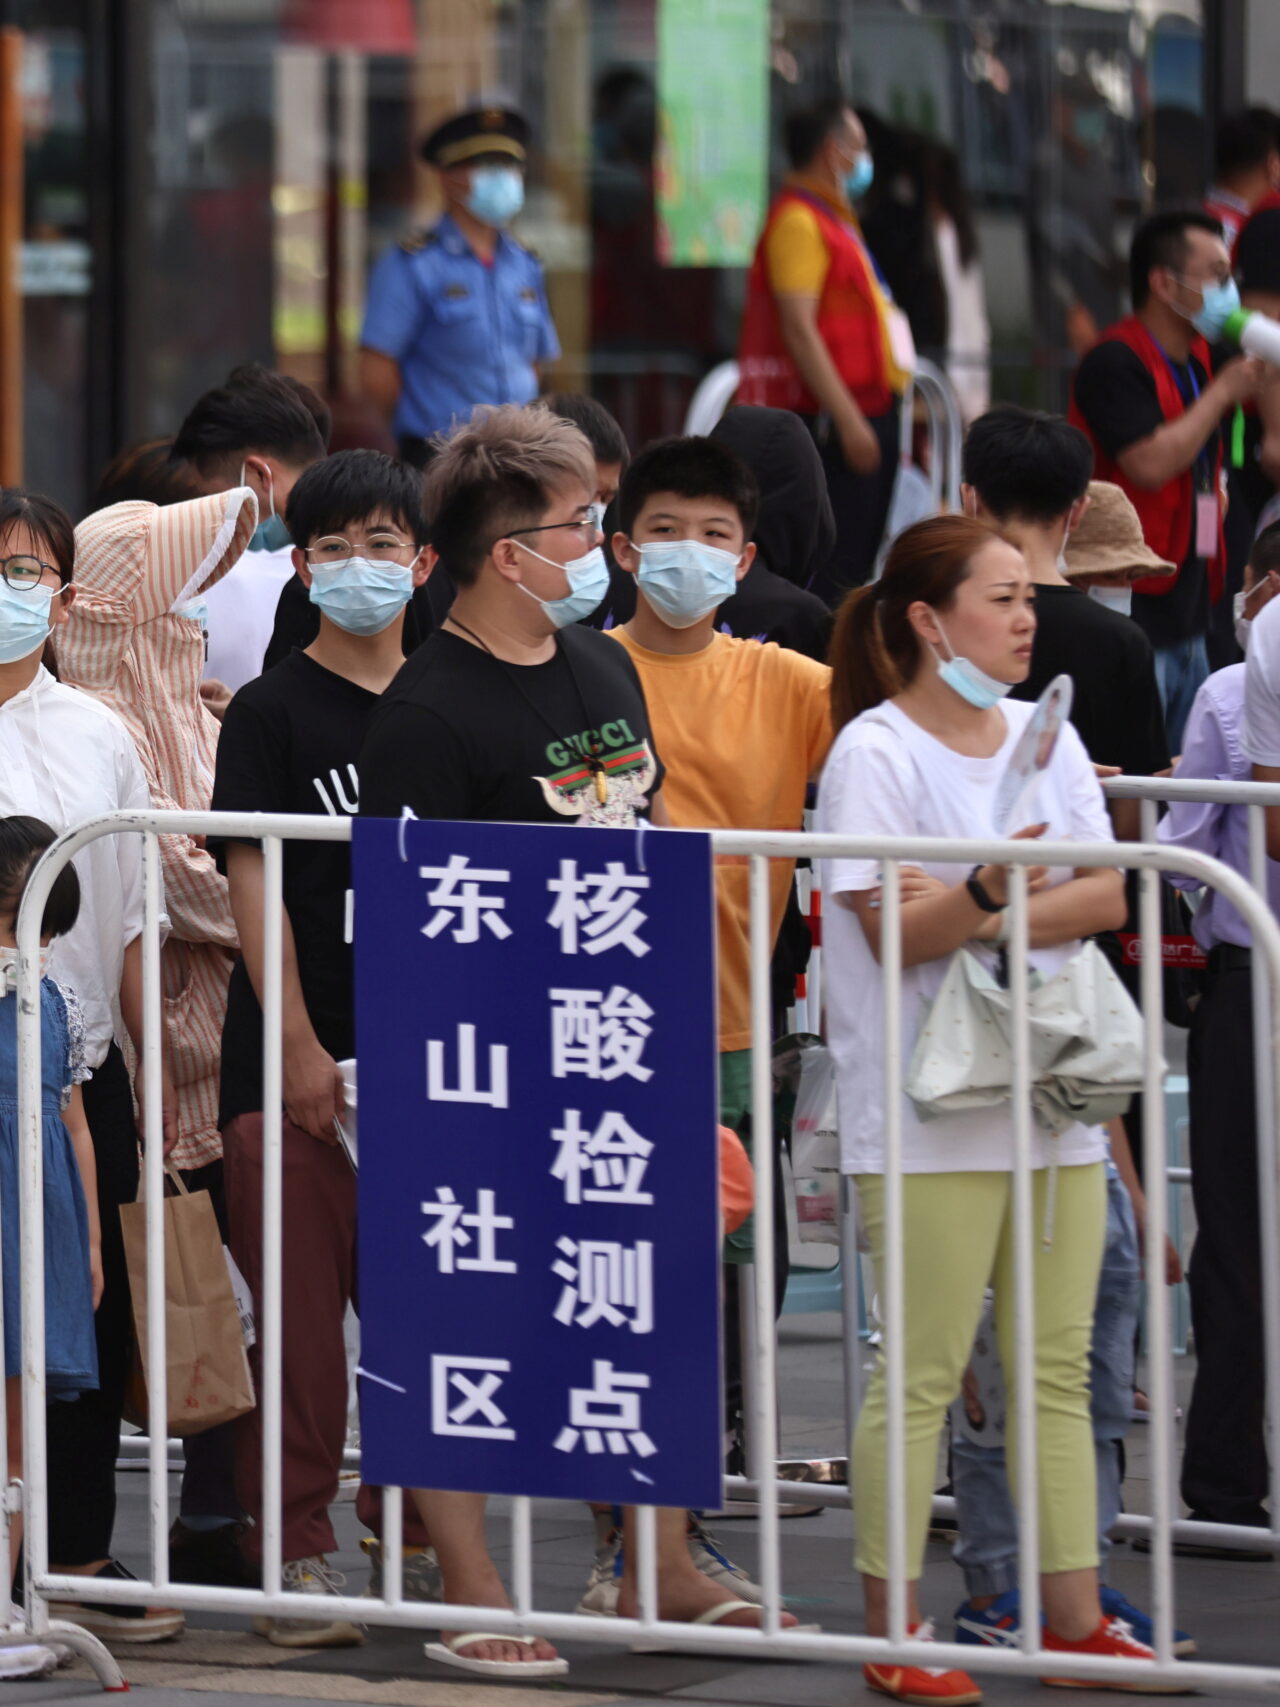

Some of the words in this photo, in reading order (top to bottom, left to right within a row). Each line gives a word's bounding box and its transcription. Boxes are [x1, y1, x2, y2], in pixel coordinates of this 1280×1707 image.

[545, 718, 636, 767] GUCCI
[419, 854, 517, 1441] 东山社区
[546, 857, 658, 1458] 核酸检测点
